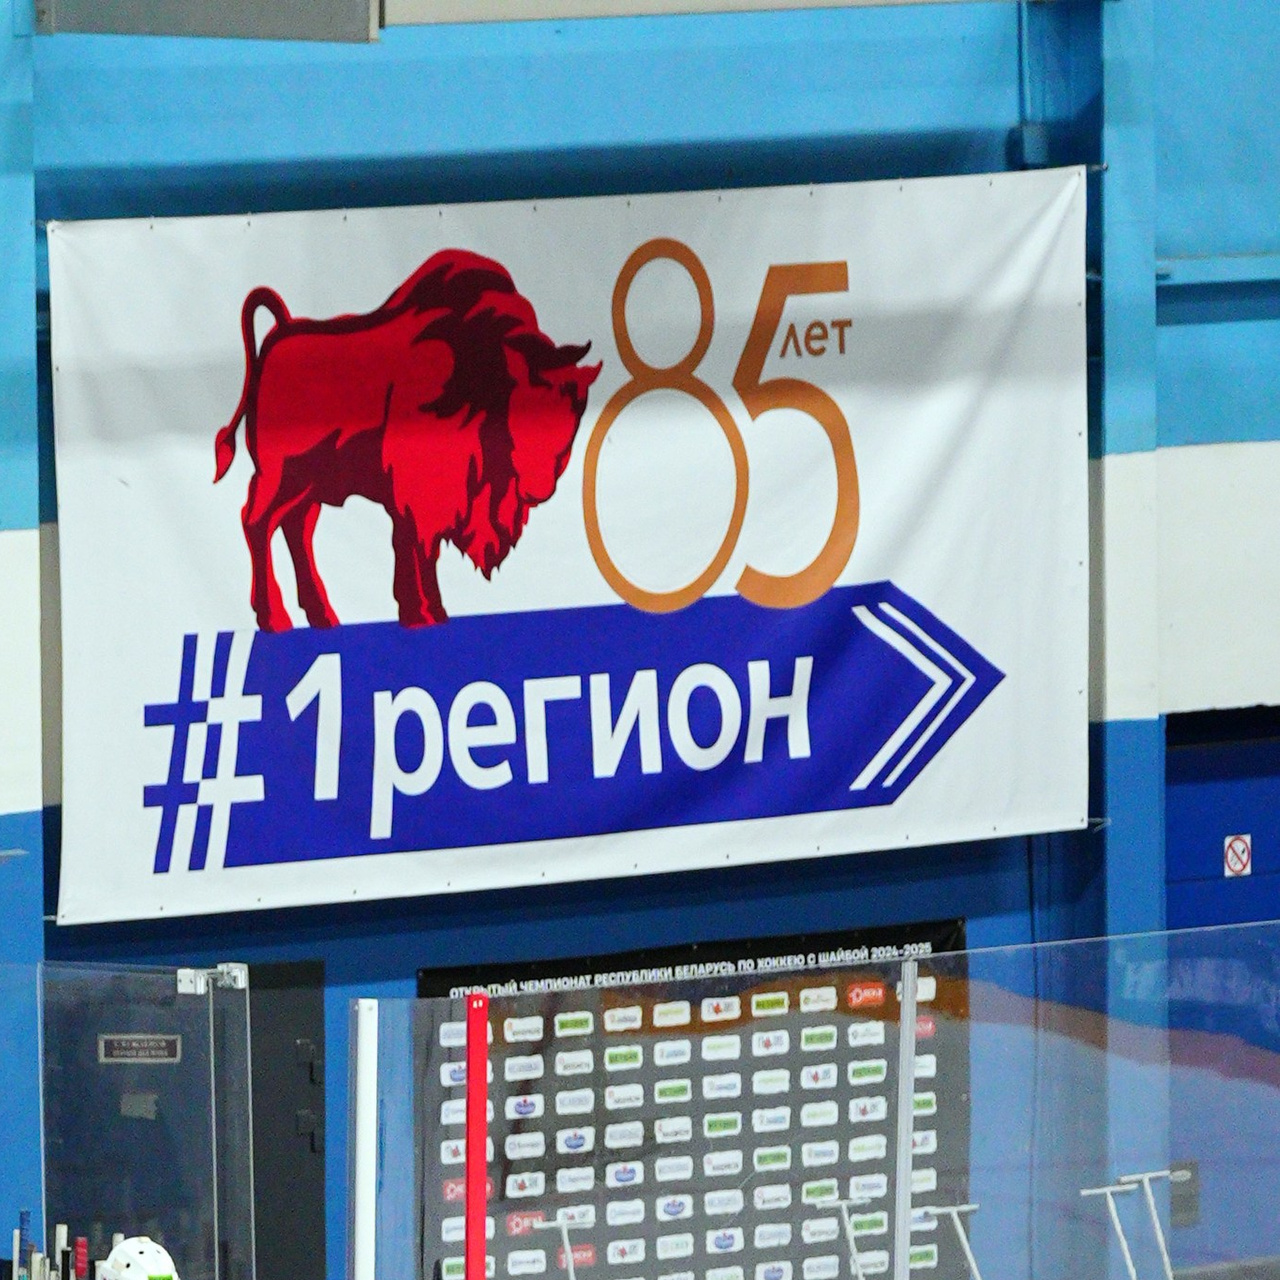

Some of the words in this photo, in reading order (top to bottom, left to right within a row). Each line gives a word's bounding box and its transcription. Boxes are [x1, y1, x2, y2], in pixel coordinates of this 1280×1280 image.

[779, 317, 852, 360] лет
[583, 238, 860, 614] 85
[520, 973, 592, 992] ЧЕМПИОНАТ
[594, 966, 672, 986] РЕСПУБЛИКИ
[674, 960, 735, 978] БЕЛАРУСЬ
[738, 958, 755, 972] ПО
[757, 954, 805, 971] ХОККЕЮ
[807, 952, 815, 965] С
[818, 946, 868, 964] ШАЙБОЙ
[870, 941, 932, 960] 2024-2025
